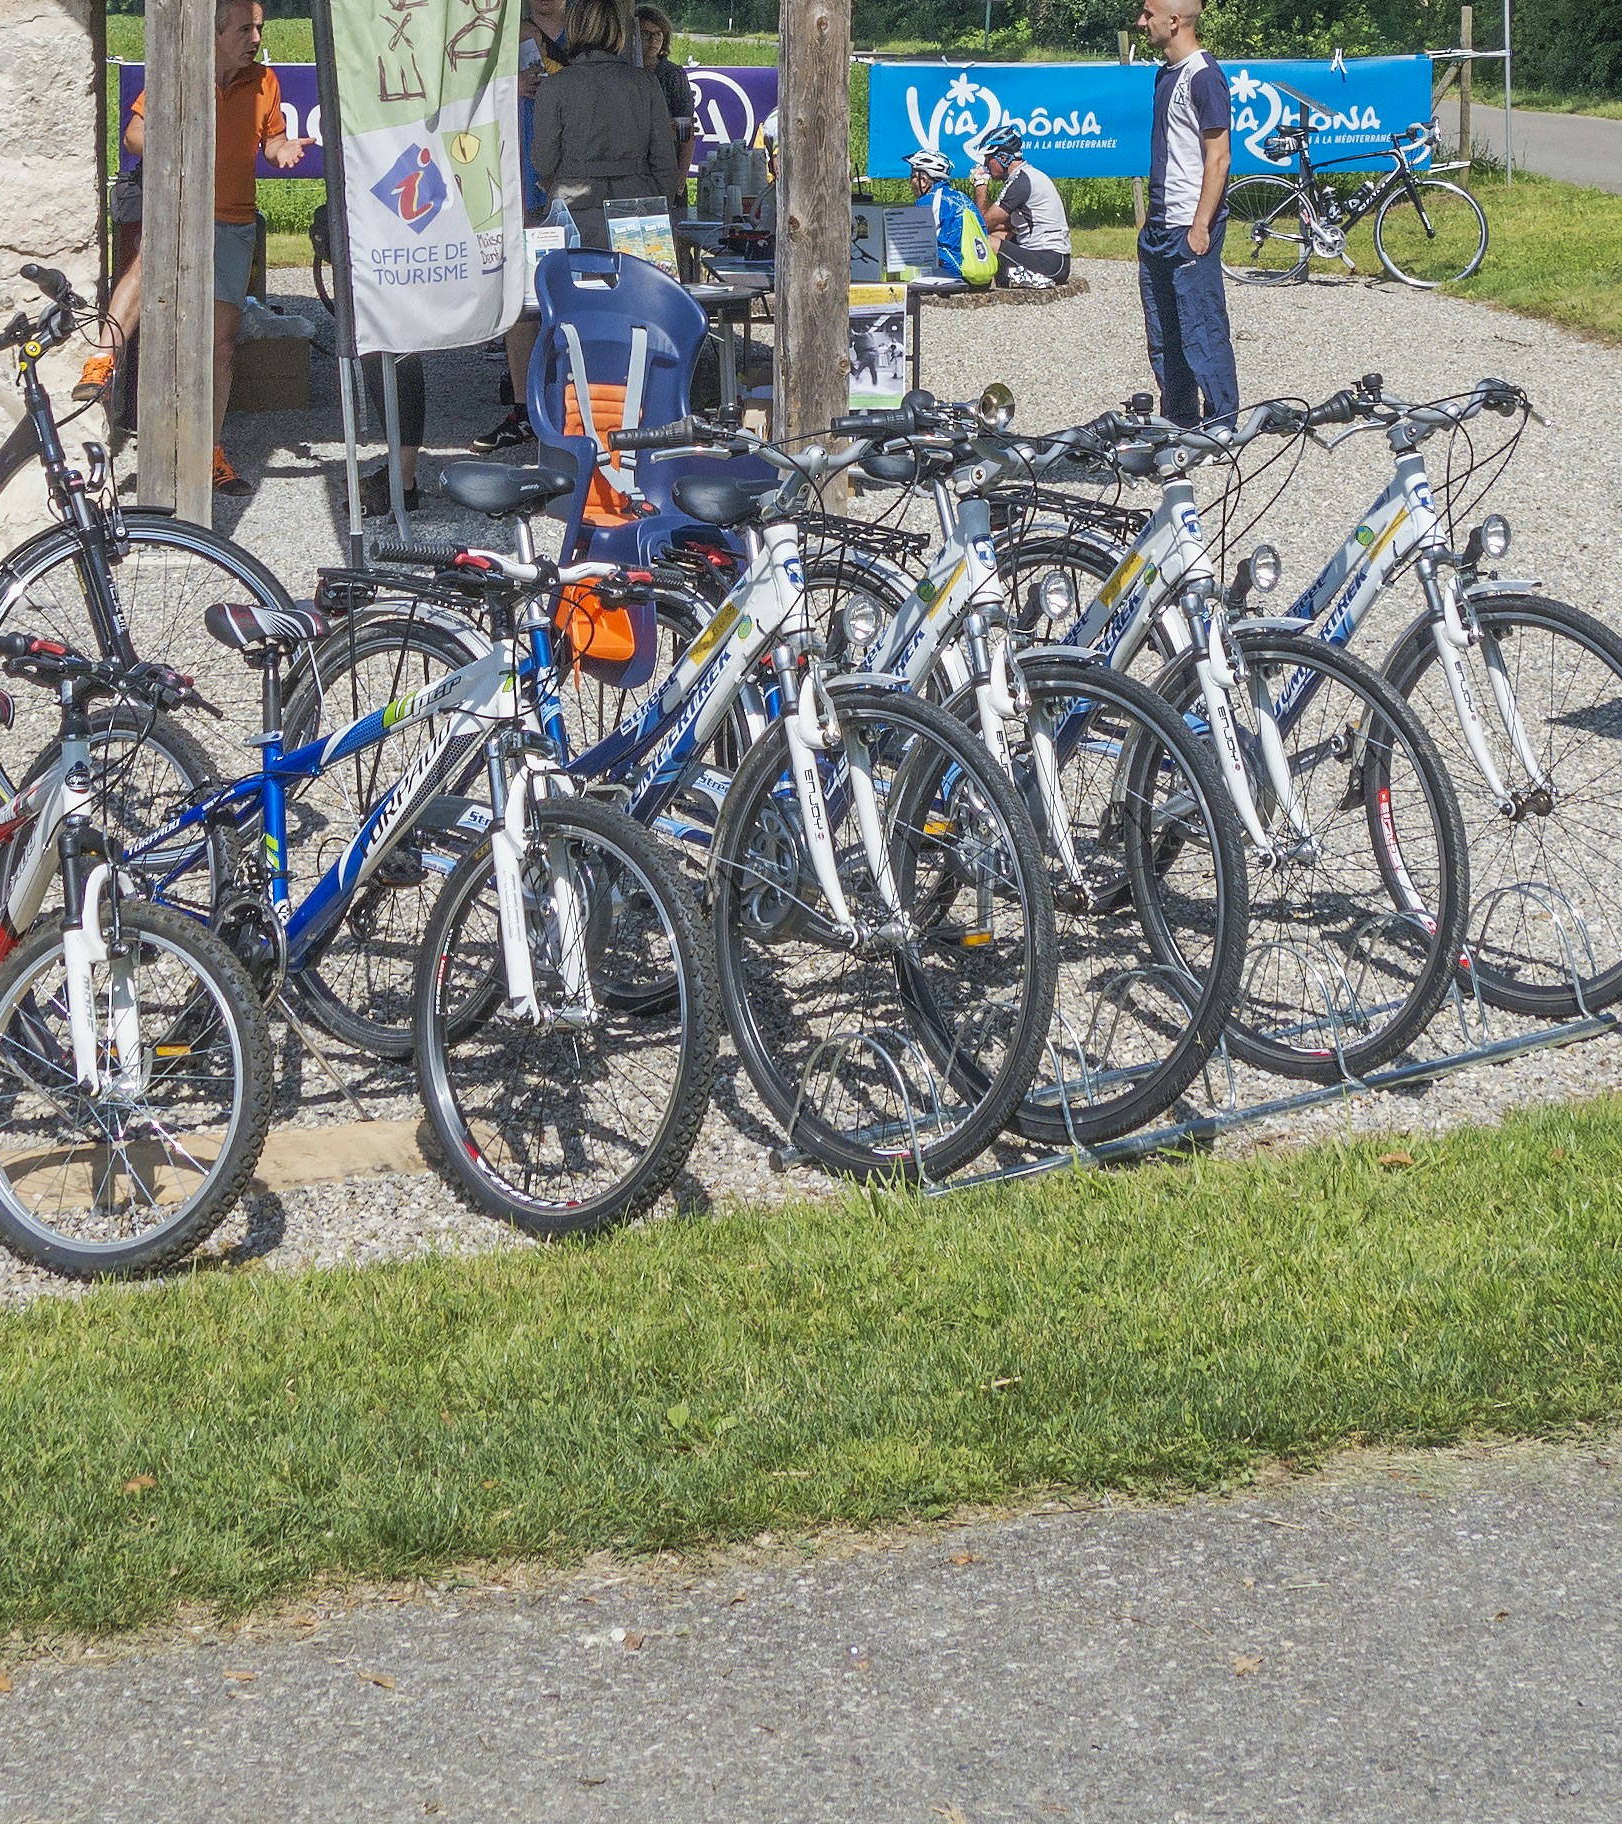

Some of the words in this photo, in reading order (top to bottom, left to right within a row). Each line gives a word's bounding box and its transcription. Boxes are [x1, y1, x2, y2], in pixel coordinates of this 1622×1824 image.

[1033, 139, 1041, 150] À
[1042, 140, 1053, 150] LA
[1055, 138, 1118, 150] MÉDITERRANÉE
[1315, 133, 1322, 145] À
[1322, 135, 1333, 145] LA
[1335, 133, 1392, 145] MÉDITERRANÉ
[476, 233, 504, 248] Maiso
[371, 244, 439, 266] OFFICE
[445, 241, 468, 261] DE
[372, 262, 469, 286] TOURISME
[1454, 660, 1475, 713] ENJOY
[1217, 705, 1239, 762] ENJOY
[803, 768, 824, 831] ENJOY
[129, 818, 181, 856] TORPADO
